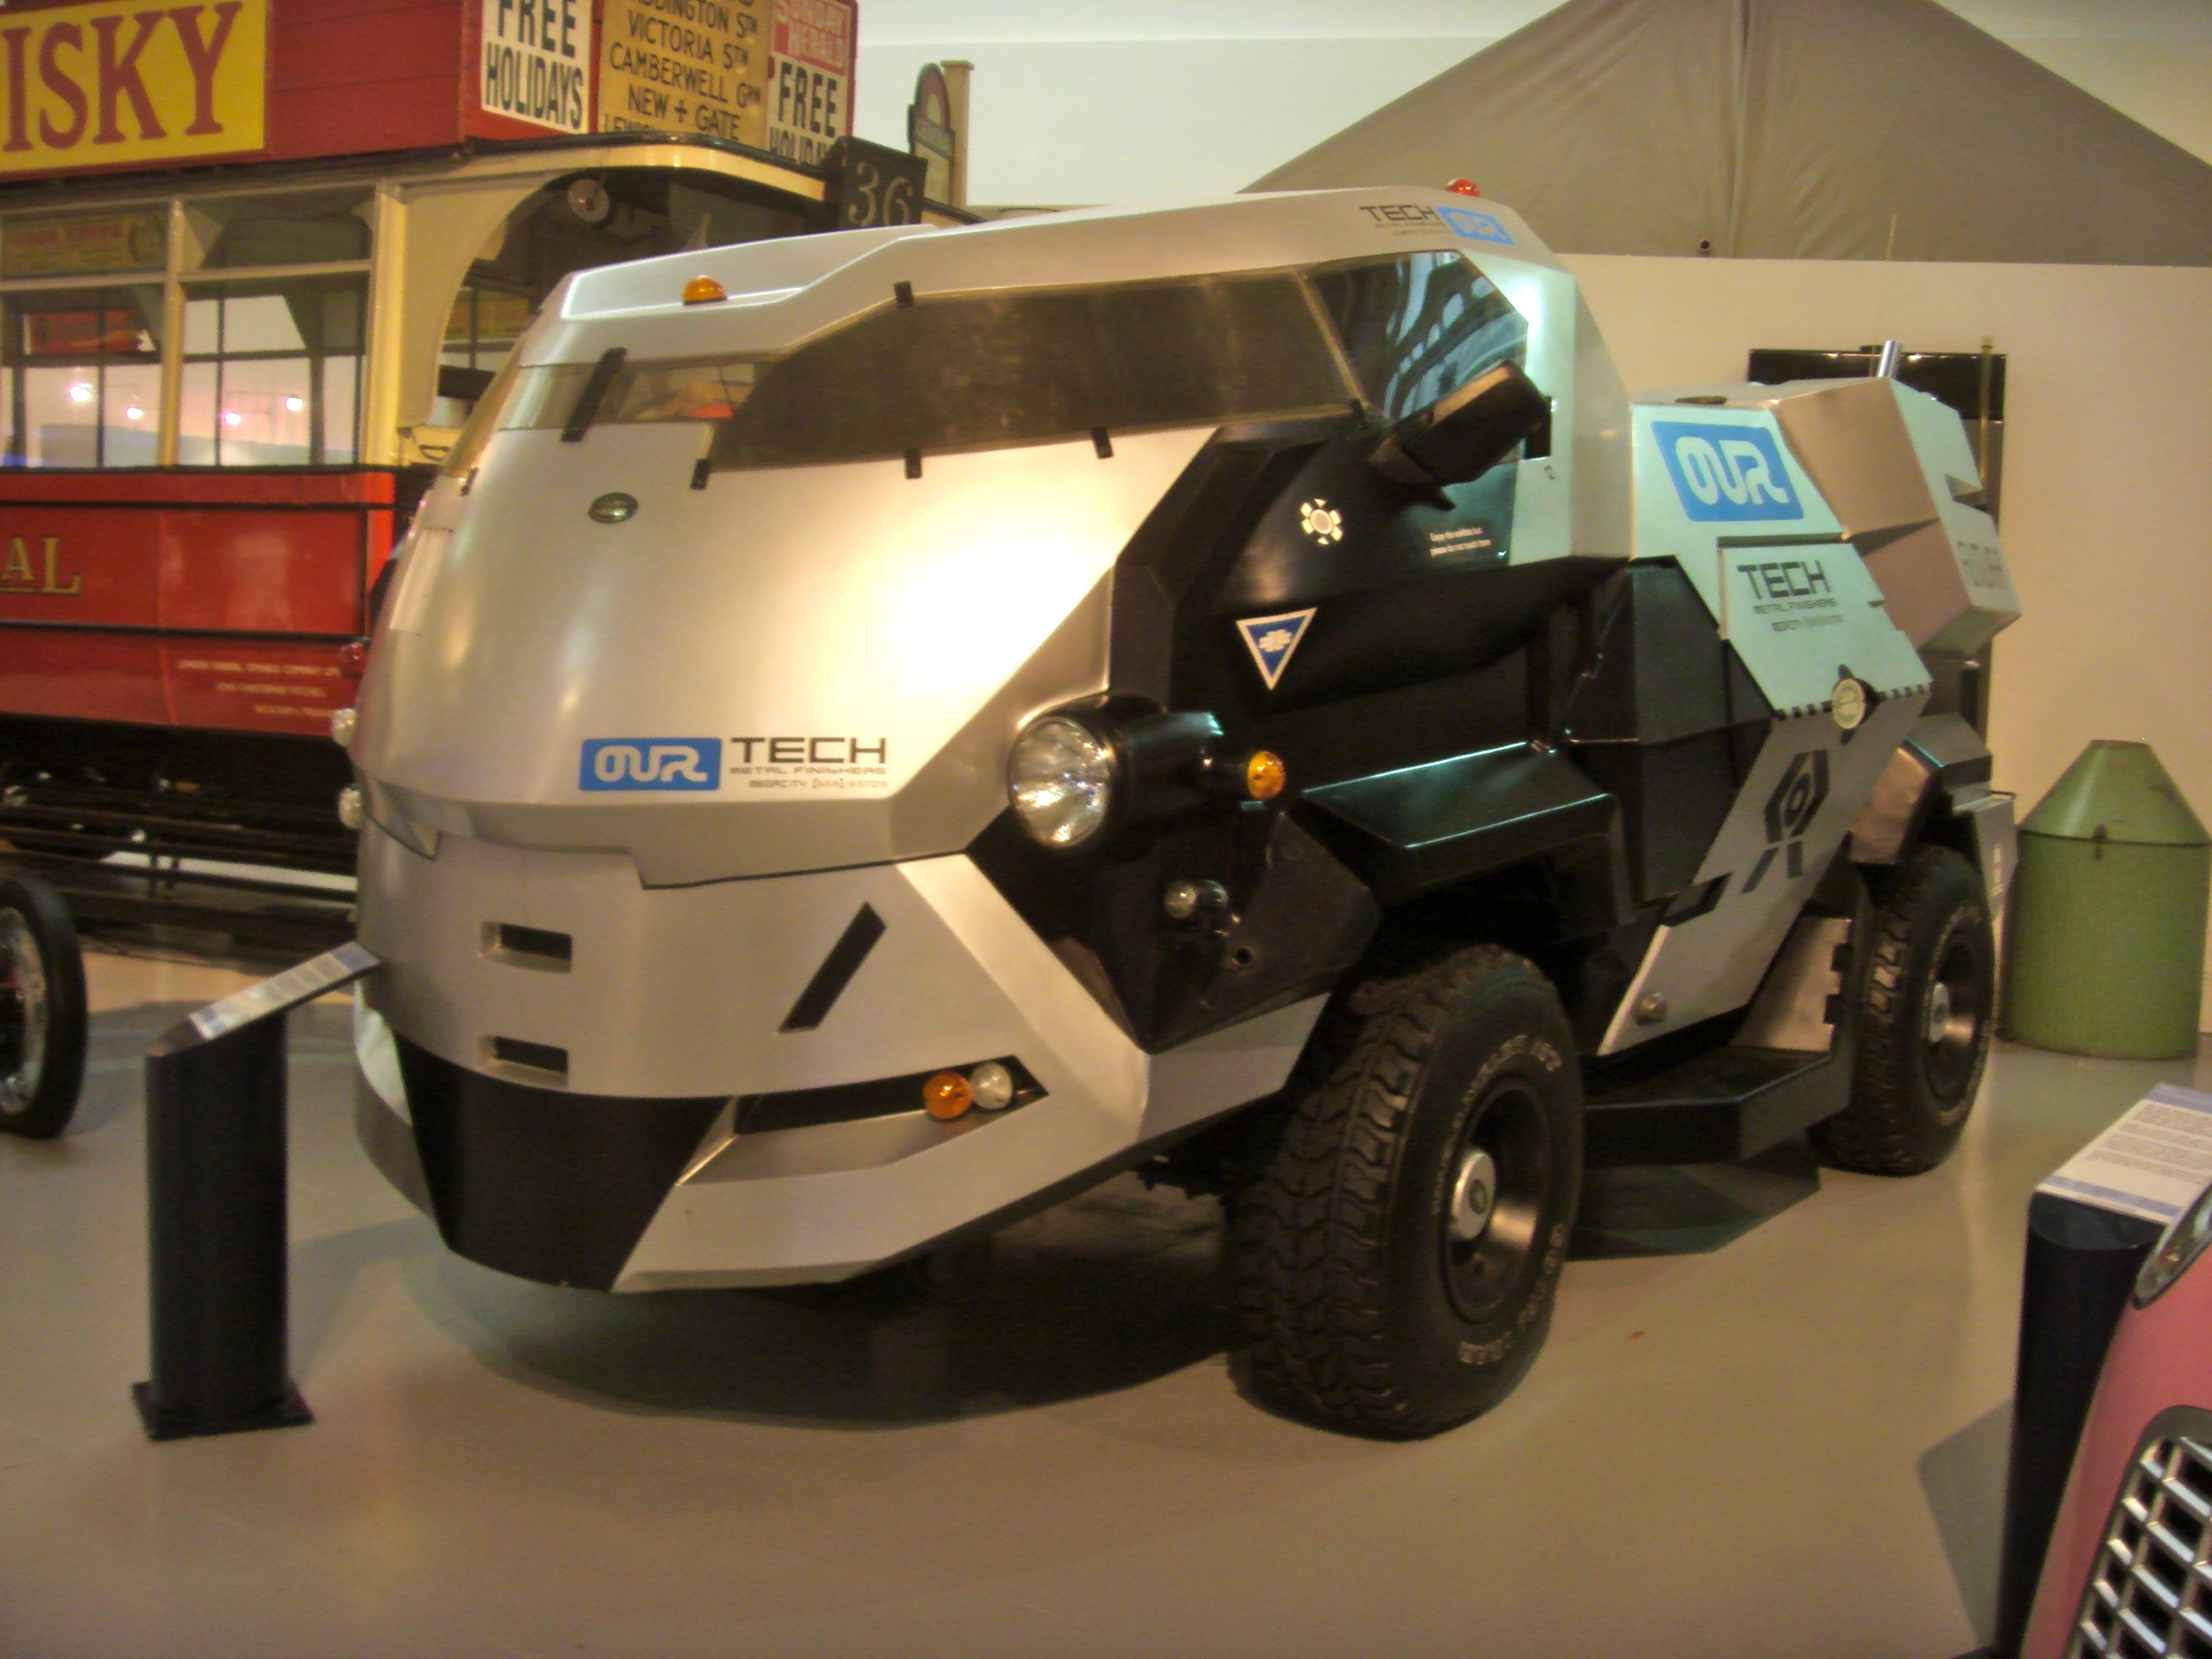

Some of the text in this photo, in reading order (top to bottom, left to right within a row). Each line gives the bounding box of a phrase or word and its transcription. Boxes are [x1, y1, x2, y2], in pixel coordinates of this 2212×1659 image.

[628, 9, 714, 65] VICTORIA
[2, 2, 243, 152] ISKY
[485, 41, 584, 130] HOLIDAYS
[609, 41, 728, 104] CAMBERWELL
[777, 61, 837, 138] FREE
[628, 84, 670, 119] NEW
[695, 104, 741, 141] GATE
[848, 161, 912, 226] 36
[1359, 204, 1441, 222] TECH
[1, 535, 81, 595] AL
[1737, 560, 1830, 600] TECH
[730, 737, 886, 763] TECH
